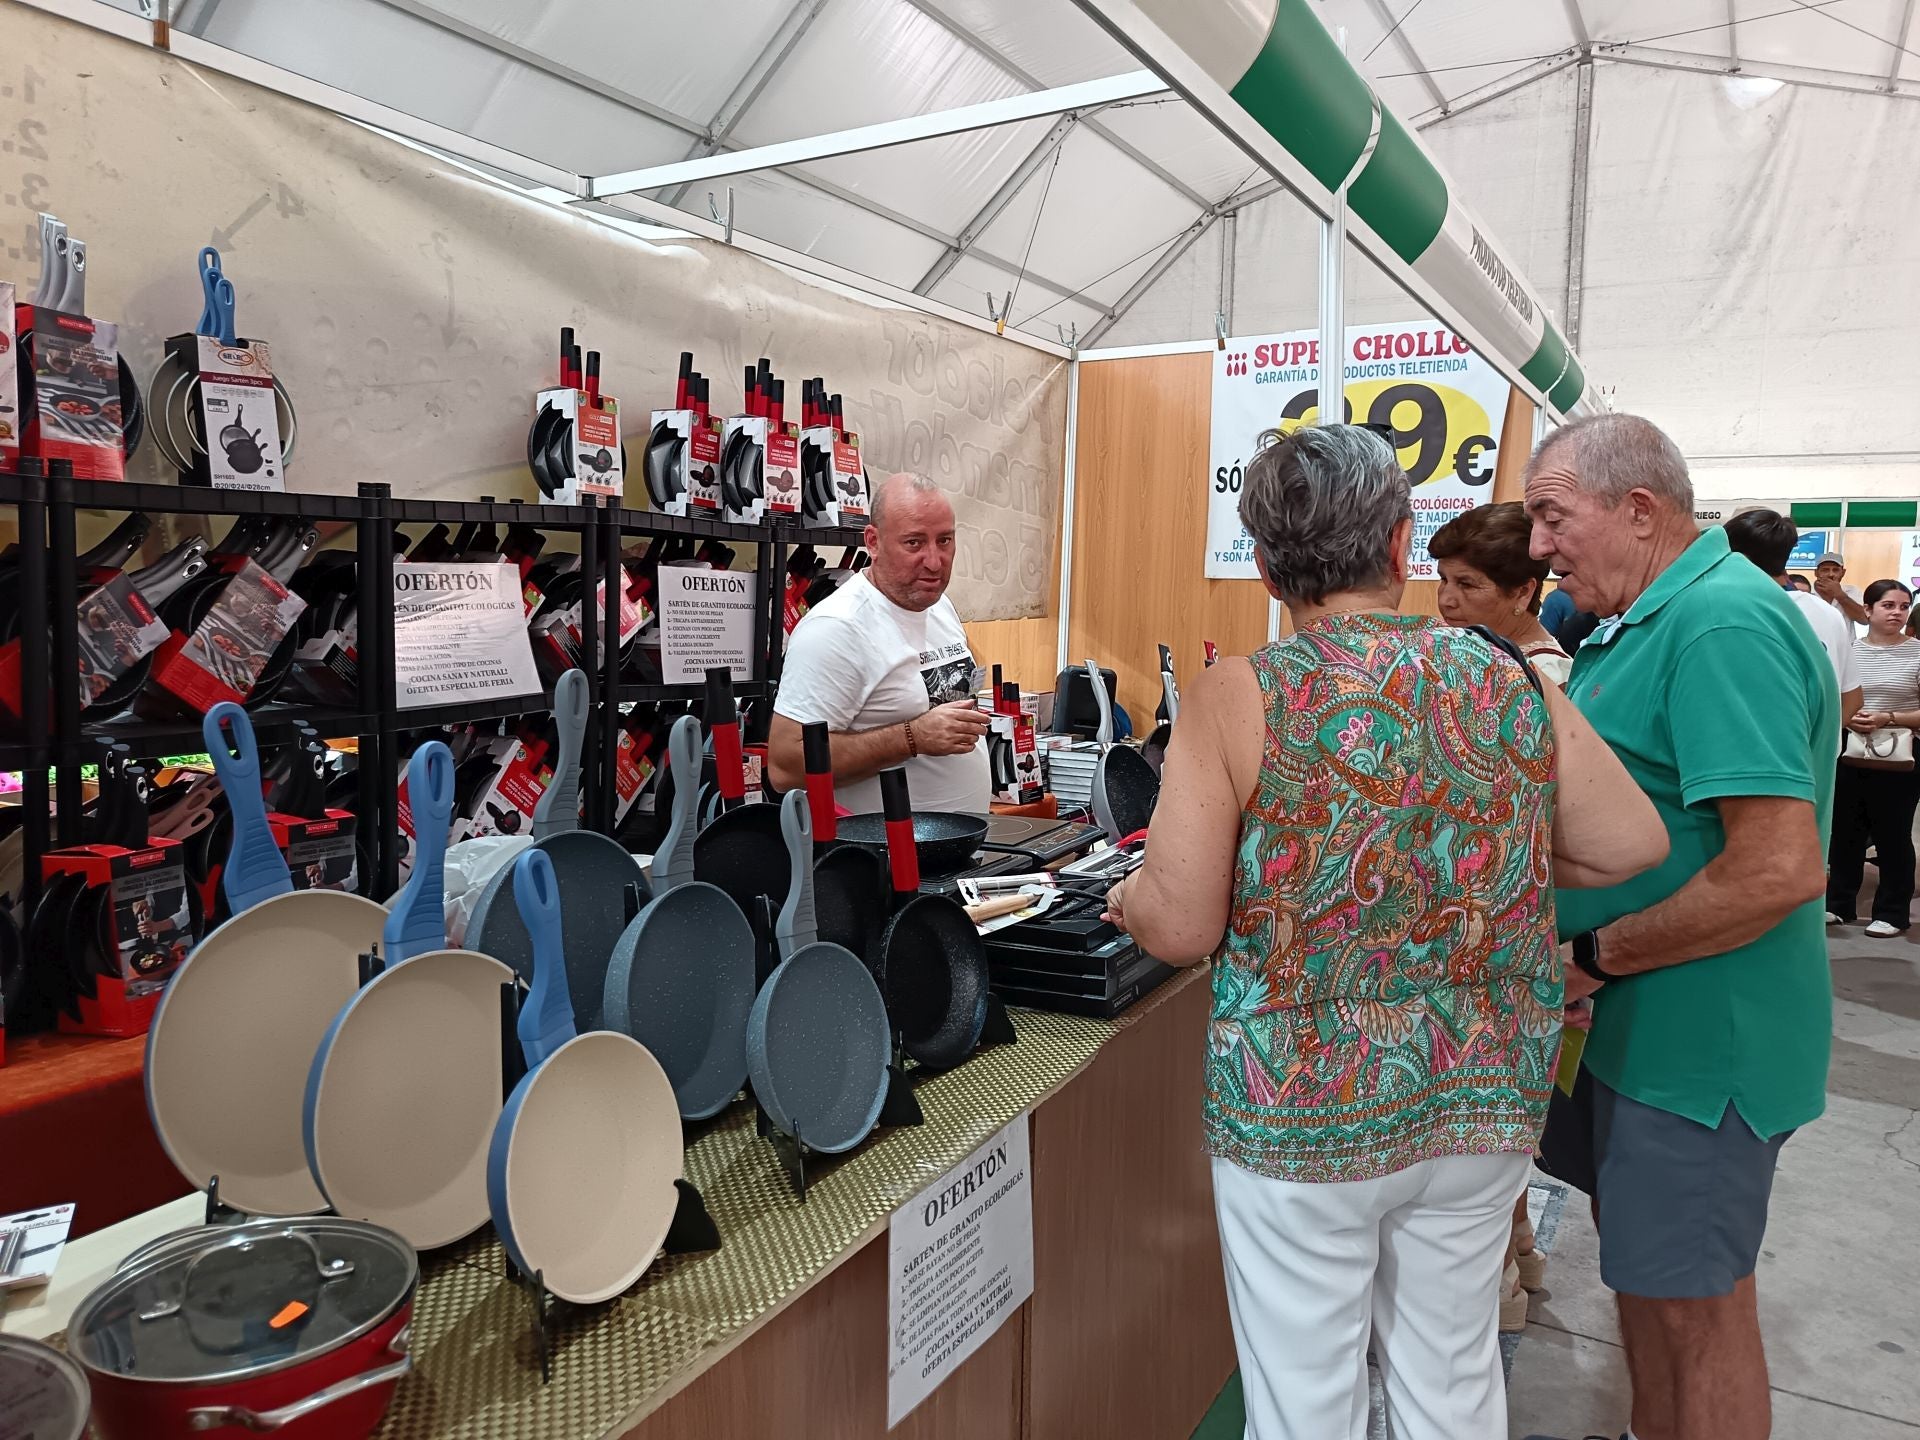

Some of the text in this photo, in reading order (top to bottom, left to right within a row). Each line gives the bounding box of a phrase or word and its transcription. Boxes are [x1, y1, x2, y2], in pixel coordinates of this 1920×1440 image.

[1470, 224, 1534, 326] PRODUCTOS TELETIENDA
[1254, 341, 1319, 368] SUPE
[1255, 358, 1468, 384] GARANTÍA D ODUCTOS TELETIENDA
[1215, 458, 1248, 494] SÓ
[1411, 495, 1475, 510] COLÓGICAS
[1232, 539, 1245, 550] DE
[1214, 551, 1221, 562] Y
[1222, 551, 1241, 562] SON
[395, 570, 493, 591] OFERTÓN
[682, 573, 745, 592] OFERTÓN
[394, 604, 408, 612] TÉN
[411, 604, 424, 612] DE
[465, 601, 515, 610] ECOLOGICAS
[667, 599, 690, 607] SARTÉN
[406, 677, 513, 695] OFERTA ESPECIAL DE FERIA
[442, 671, 462, 680] SANA
[923, 1141, 1006, 1226] OFERTÓN
[903, 1168, 1023, 1277] SARTÉN DE GRANITO ECOLOGICAS
[963, 1222, 980, 1242] PEGAN
[908, 1287, 935, 1315] COCINAN
[935, 1276, 948, 1291] CON
[949, 1263, 964, 1280] POCO
[965, 1246, 984, 1267] ACEITE
[908, 1275, 933, 1300] TRICAPA
[908, 1331, 933, 1357] VALIDAS
[933, 1318, 949, 1335] PARA
[950, 1303, 965, 1321] TODO
[965, 1291, 978, 1307] TIPO
[986, 1263, 1008, 1288] COCINAS
[924, 1328, 954, 1362] ¡COCINA
[955, 1311, 973, 1332] SANA
[980, 1275, 1011, 1310] NATURAL!
[917, 1314, 937, 1335] LARGA
[921, 1287, 1013, 1378] OFERTA ESPECIAL DE FERIA
